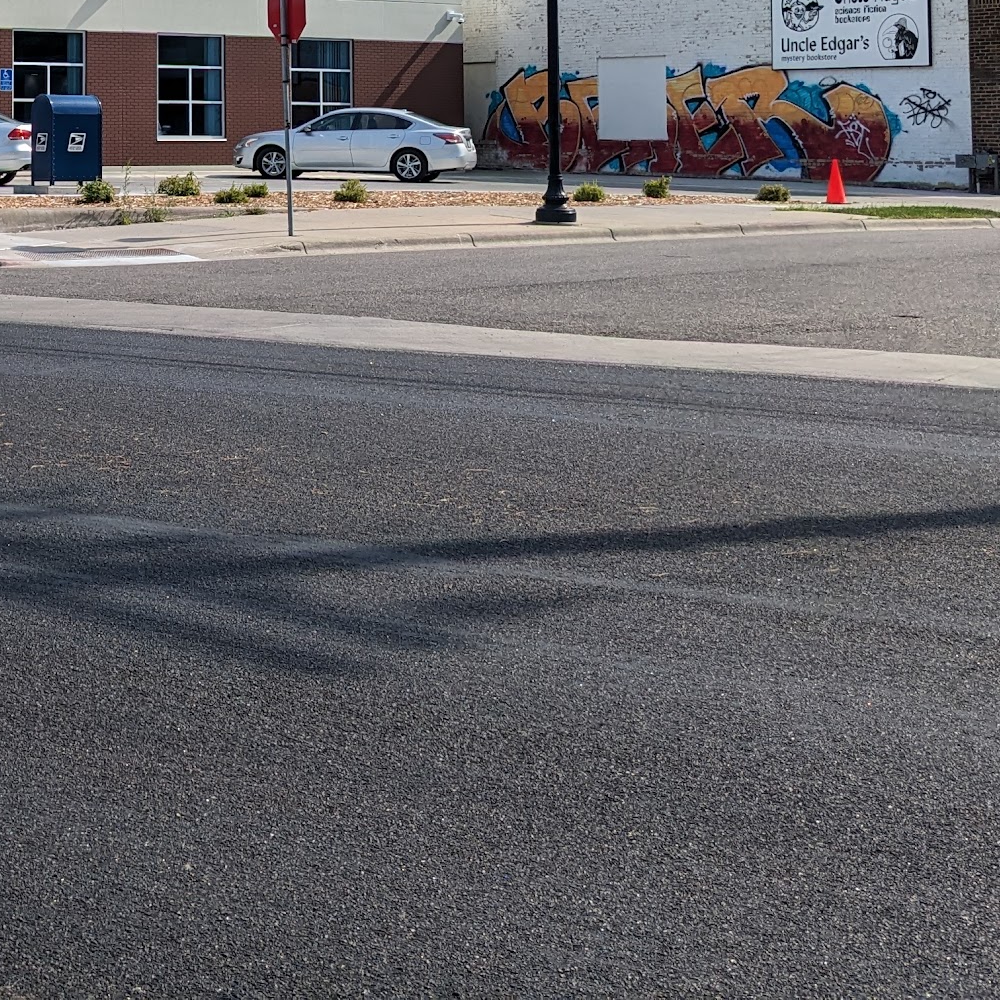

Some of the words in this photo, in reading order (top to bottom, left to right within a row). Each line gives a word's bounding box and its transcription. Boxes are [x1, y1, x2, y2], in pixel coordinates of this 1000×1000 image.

[834, 6, 861, 15] science
[863, 4, 887, 14] fiction
[781, 37, 817, 53] Uncle
[820, 35, 870, 55] Edgar's
[781, 55, 805, 63] mystery
[806, 54, 837, 62] bookstore
